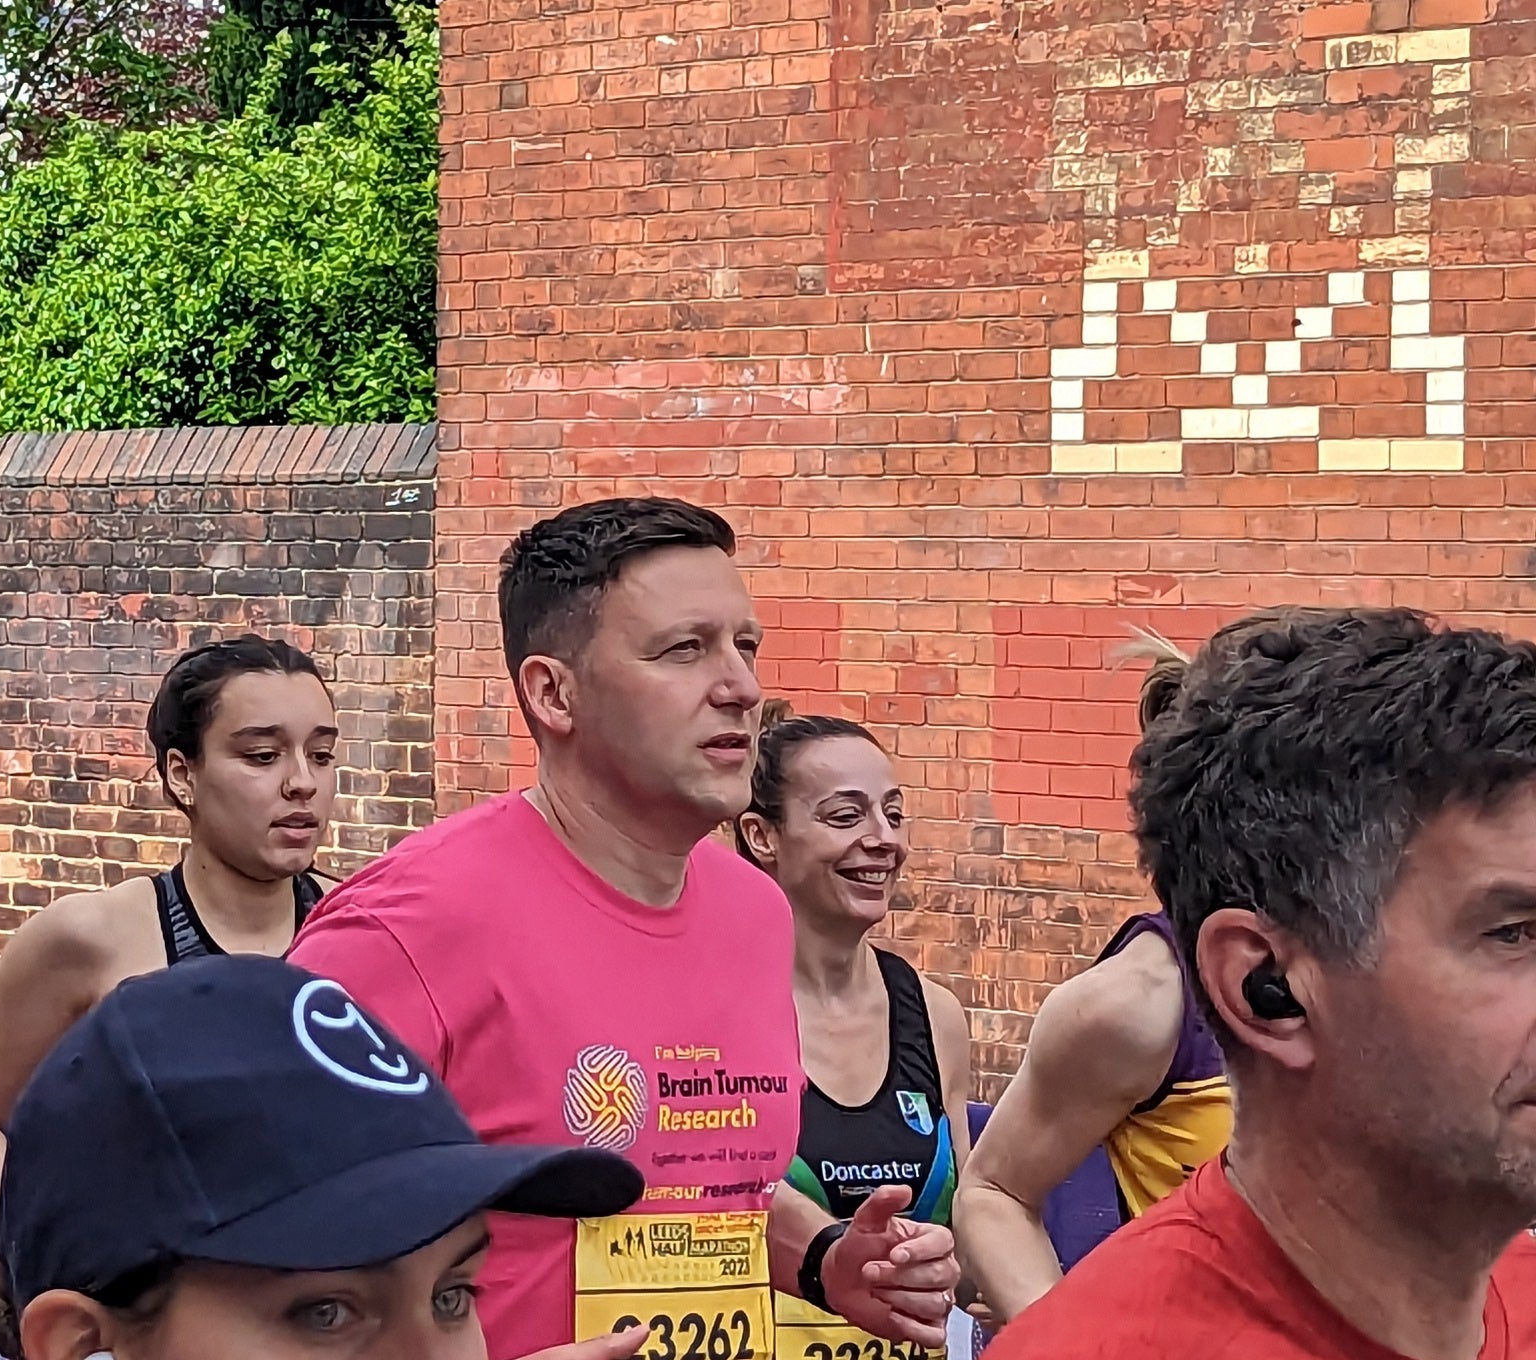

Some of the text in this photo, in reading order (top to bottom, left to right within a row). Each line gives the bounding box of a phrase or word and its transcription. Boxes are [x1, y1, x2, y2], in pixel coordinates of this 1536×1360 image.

[657, 1068, 788, 1098] Brain Tumour
[658, 1097, 757, 1132] Research
[820, 1160, 922, 1182] Doncaster
